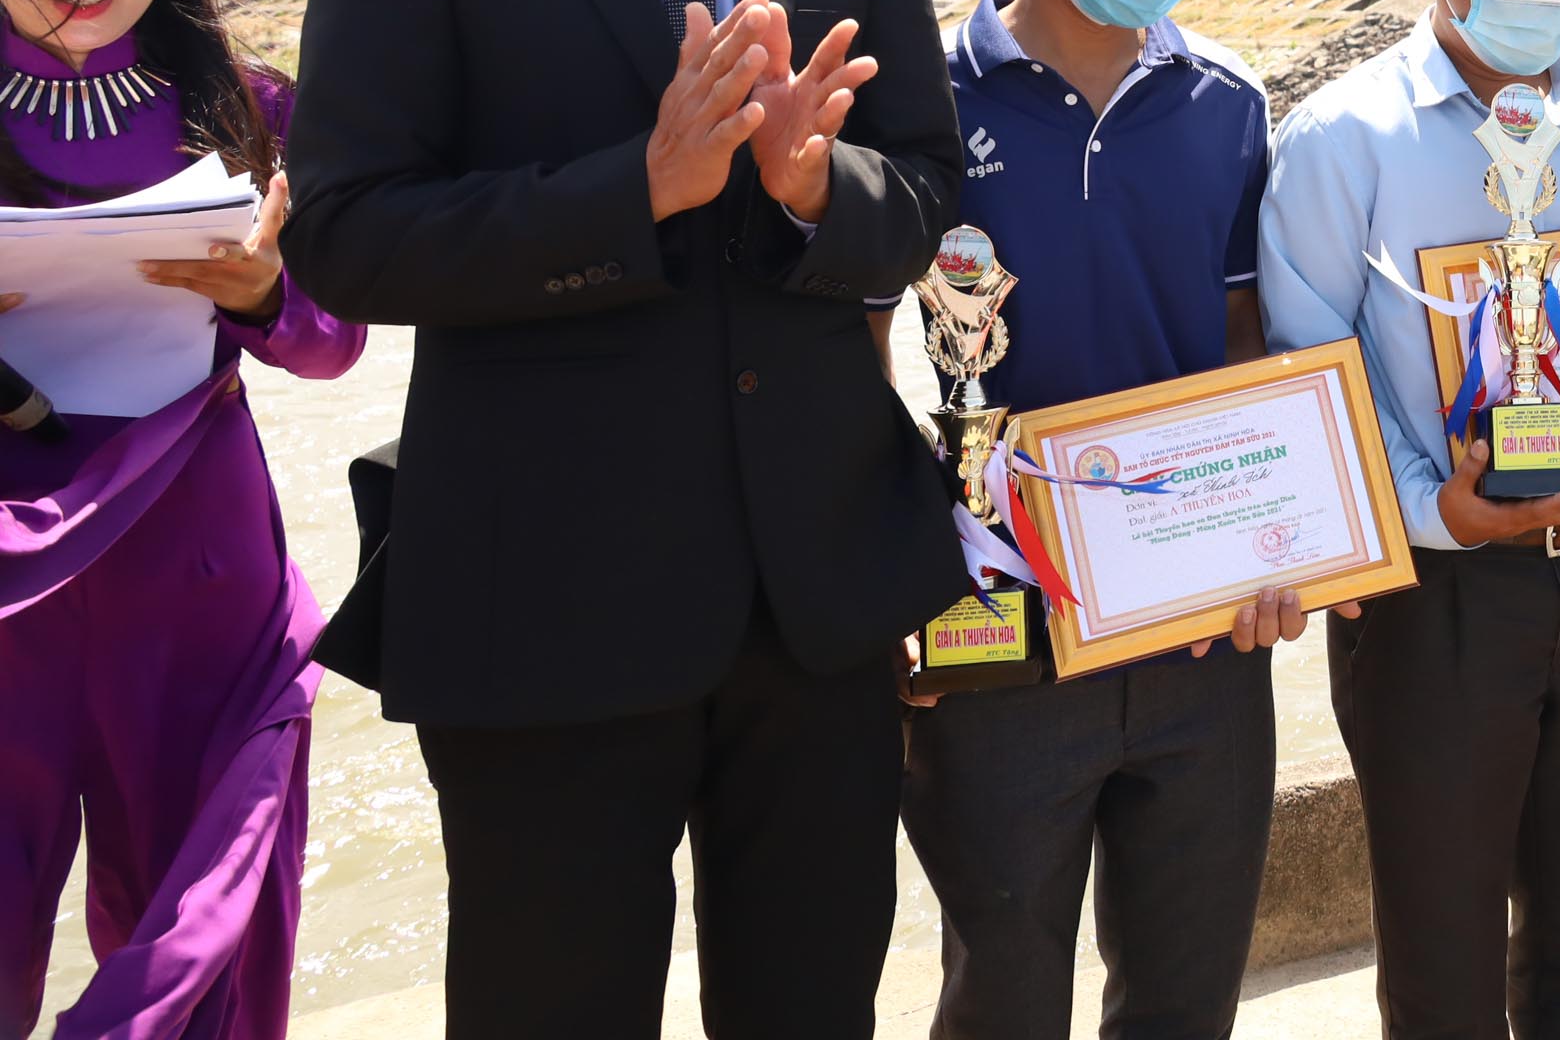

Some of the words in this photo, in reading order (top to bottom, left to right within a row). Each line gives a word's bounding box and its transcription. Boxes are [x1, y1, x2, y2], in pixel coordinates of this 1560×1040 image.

[1210, 70, 1241, 91] ENERGY
[967, 161, 1004, 178] egan
[1124, 463, 1138, 472] BAN
[1140, 460, 1149, 468] TỔ
[1149, 454, 1170, 466] CHỨC
[1171, 451, 1183, 461] TẾT
[1185, 445, 1214, 458] NGUYÊN
[1231, 436, 1245, 447] TÂN
[1262, 431, 1276, 439] 2021
[1151, 448, 1165, 458] BAN
[1213, 434, 1223, 442] XÃ
[1224, 431, 1240, 439] NINH
[1502, 430, 1517, 454] GIẢI
[1519, 437, 1525, 453] A
[1526, 428, 1557, 453] THUYỀN
[1171, 457, 1234, 485] CHỨNG
[1239, 444, 1288, 468] NHẬN
[1170, 506, 1179, 517] A
[1181, 493, 1225, 513] THUYỀN
[1228, 486, 1252, 501] HOA
[1181, 520, 1195, 528] hoa
[1280, 494, 1297, 504] Dinh
[935, 623, 953, 648] GIẢI
[954, 630, 961, 648] A
[962, 619, 997, 646] THUYỀN
[998, 625, 1016, 643] HOA
